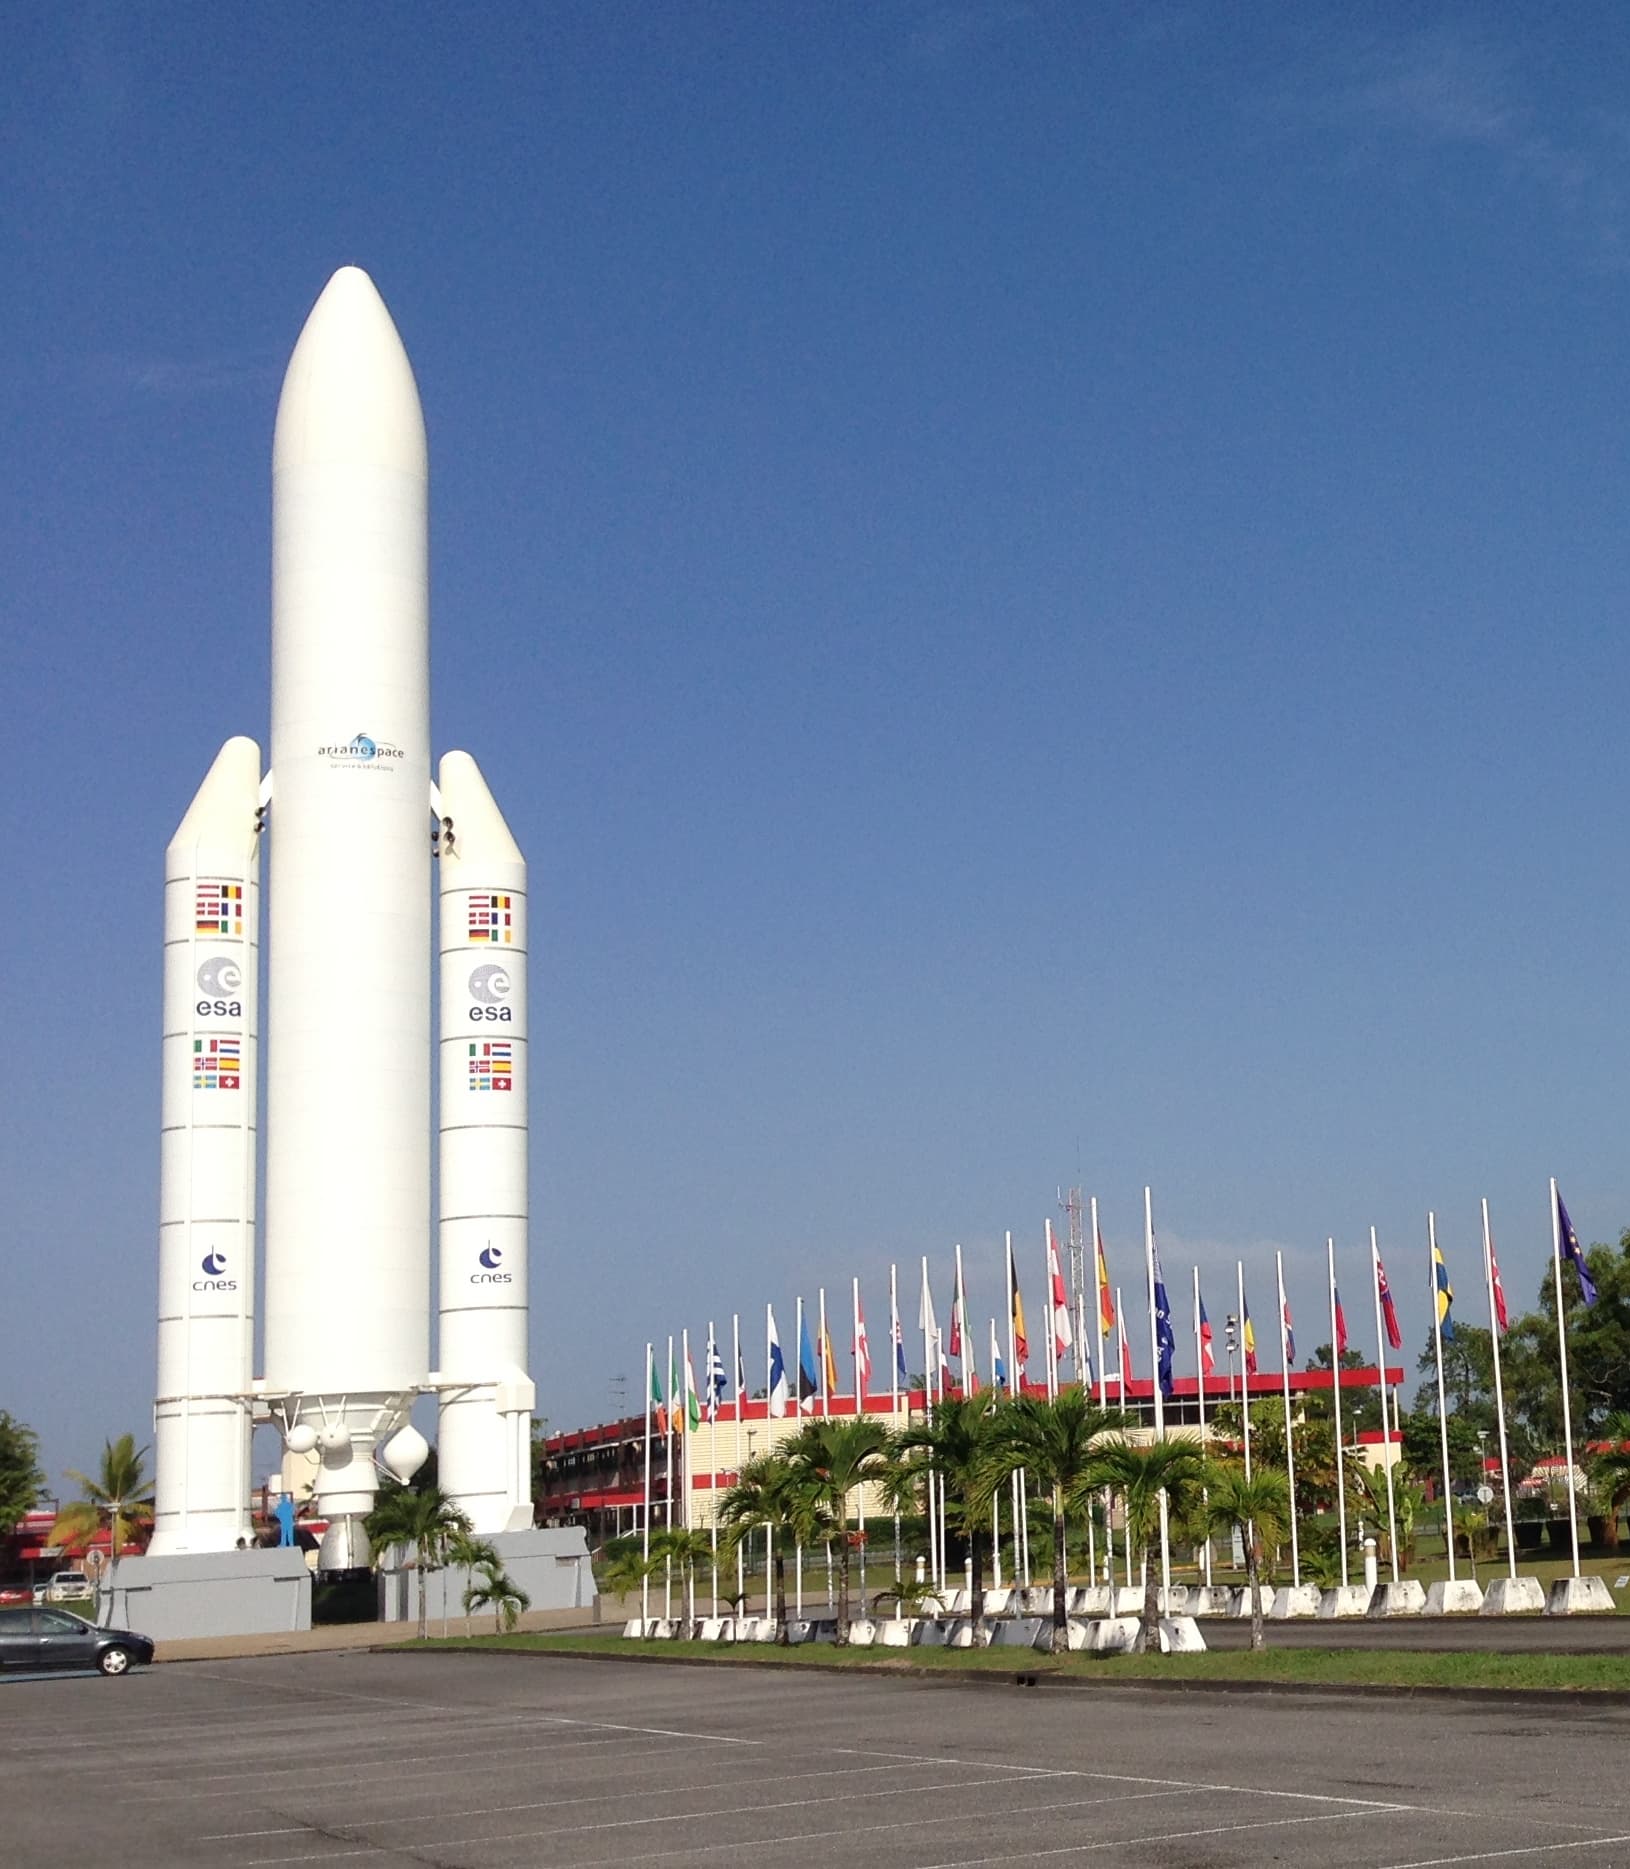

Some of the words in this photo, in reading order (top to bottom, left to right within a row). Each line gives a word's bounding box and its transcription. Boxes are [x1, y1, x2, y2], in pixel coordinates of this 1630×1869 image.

[317, 743, 405, 759] arianespace
[196, 1000, 242, 1017] esa
[469, 1006, 512, 1022] esa
[192, 1280, 237, 1291] cnes
[470, 1273, 512, 1284] cnes
